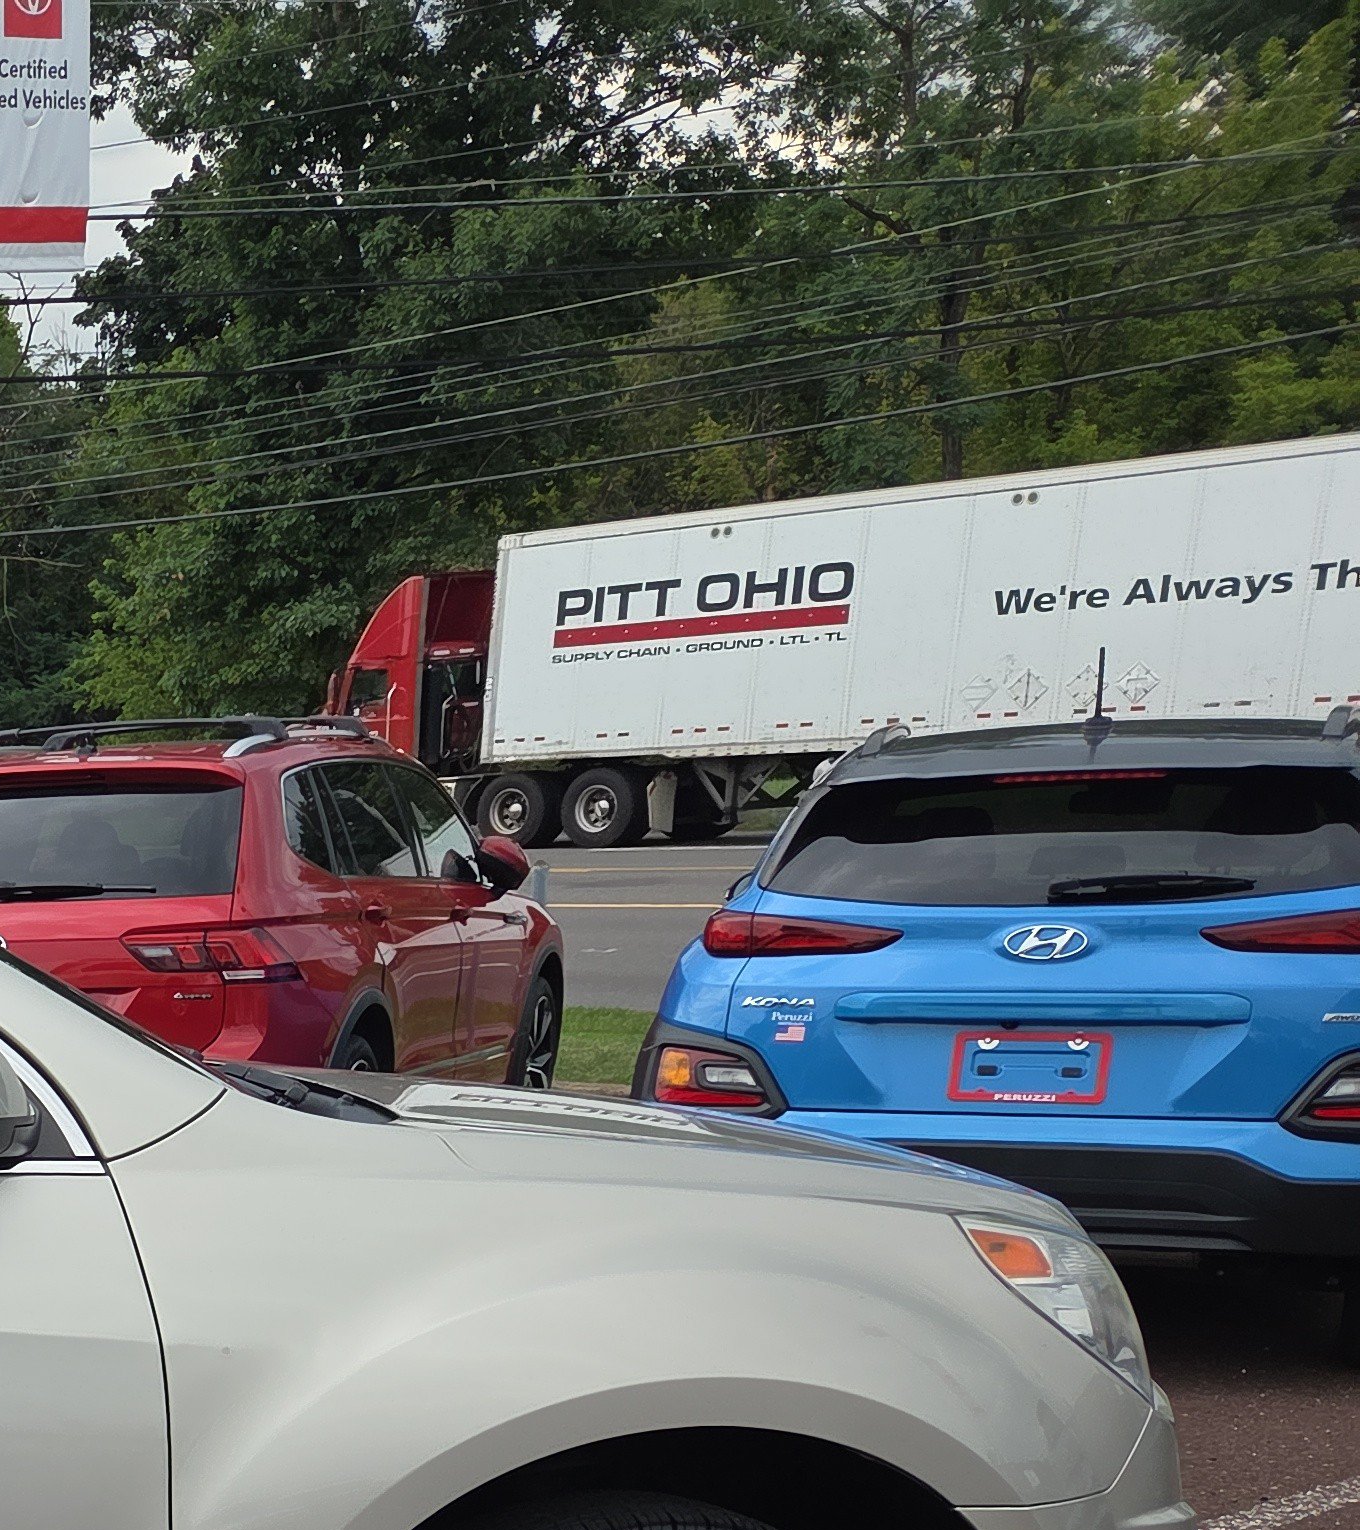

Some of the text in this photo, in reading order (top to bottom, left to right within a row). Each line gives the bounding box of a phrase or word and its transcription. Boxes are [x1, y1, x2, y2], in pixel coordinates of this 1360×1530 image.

[23, 89, 87, 110] Vehicles
[556, 561, 855, 627] PITT OHIO
[994, 585, 1110, 616] We're
[1122, 572, 1293, 604] Always
[551, 631, 847, 664] SUPPLY CHAIN GROUND LTL TL
[741, 996, 815, 1008] KONA
[771, 1011, 813, 1022] Peruzzi
[993, 1093, 1056, 1102] PERUZZI
